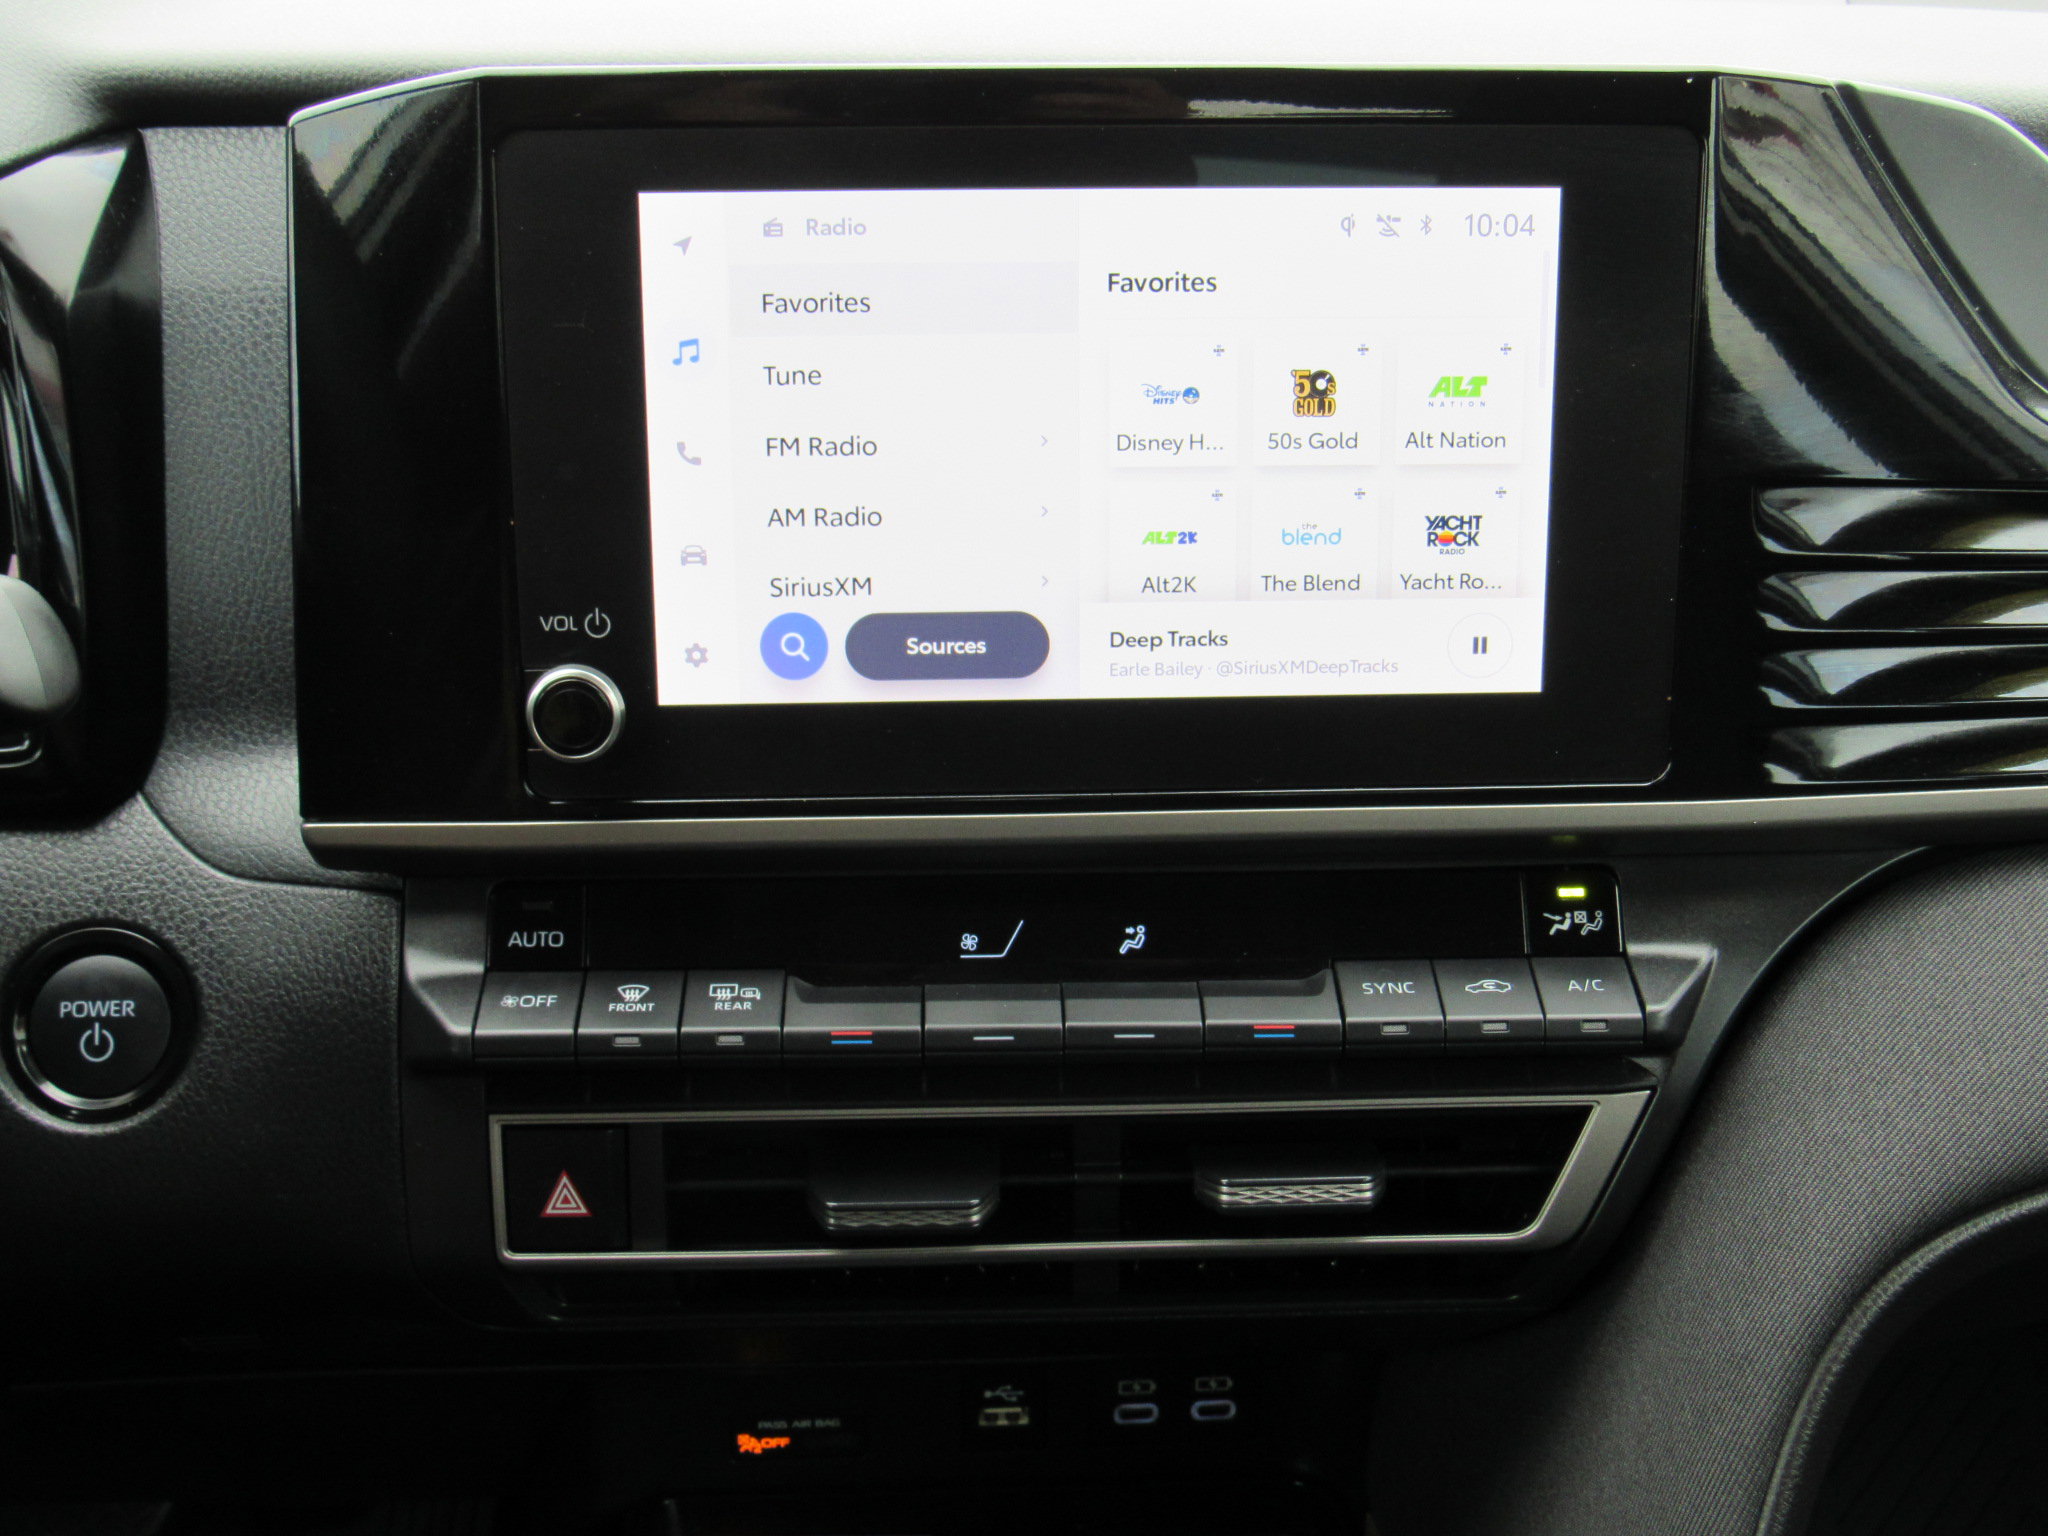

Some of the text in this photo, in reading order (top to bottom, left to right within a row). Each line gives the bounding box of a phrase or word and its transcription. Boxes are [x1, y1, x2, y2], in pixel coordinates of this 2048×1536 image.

[805, 217, 867, 236] Radio
[1465, 213, 1536, 237] 10:04
[1108, 270, 1218, 293] Favorites
[762, 291, 871, 314] Favorites
[762, 365, 822, 386] Tune
[1430, 375, 1489, 398] ALT
[1152, 397, 1176, 405] HITS
[1294, 396, 1337, 417] GOLD
[766, 435, 878, 457] FM Radio
[1116, 433, 1184, 456] Disney
[1267, 431, 1358, 450] 50s Gold
[1404, 431, 1506, 449] Alt Nation
[767, 505, 883, 528] AM Radio
[1425, 514, 1483, 531] YACHT
[1301, 523, 1318, 531] the
[1281, 528, 1343, 546] blend
[1427, 530, 1479, 547] ROCK
[770, 576, 872, 598] SiriusXM
[1141, 575, 1197, 594] Alt2K
[1260, 573, 1361, 592] The Blend
[1400, 572, 1455, 591] Yacht
[539, 615, 578, 632] VOL
[906, 637, 987, 655] Sources
[1109, 629, 1229, 652] Deep Tracks
[1109, 655, 1399, 680] Earle Bailey @SiriusXMDeepTracks
[507, 930, 564, 948] AUTO
[1362, 977, 1416, 995] SYNC
[1567, 978, 1605, 992] A/C
[59, 999, 135, 1018] POWER
[520, 995, 558, 1008] OFF
[608, 1002, 655, 1013] FRONT
[713, 1001, 752, 1012] REAR
[761, 1437, 791, 1448] OFF
